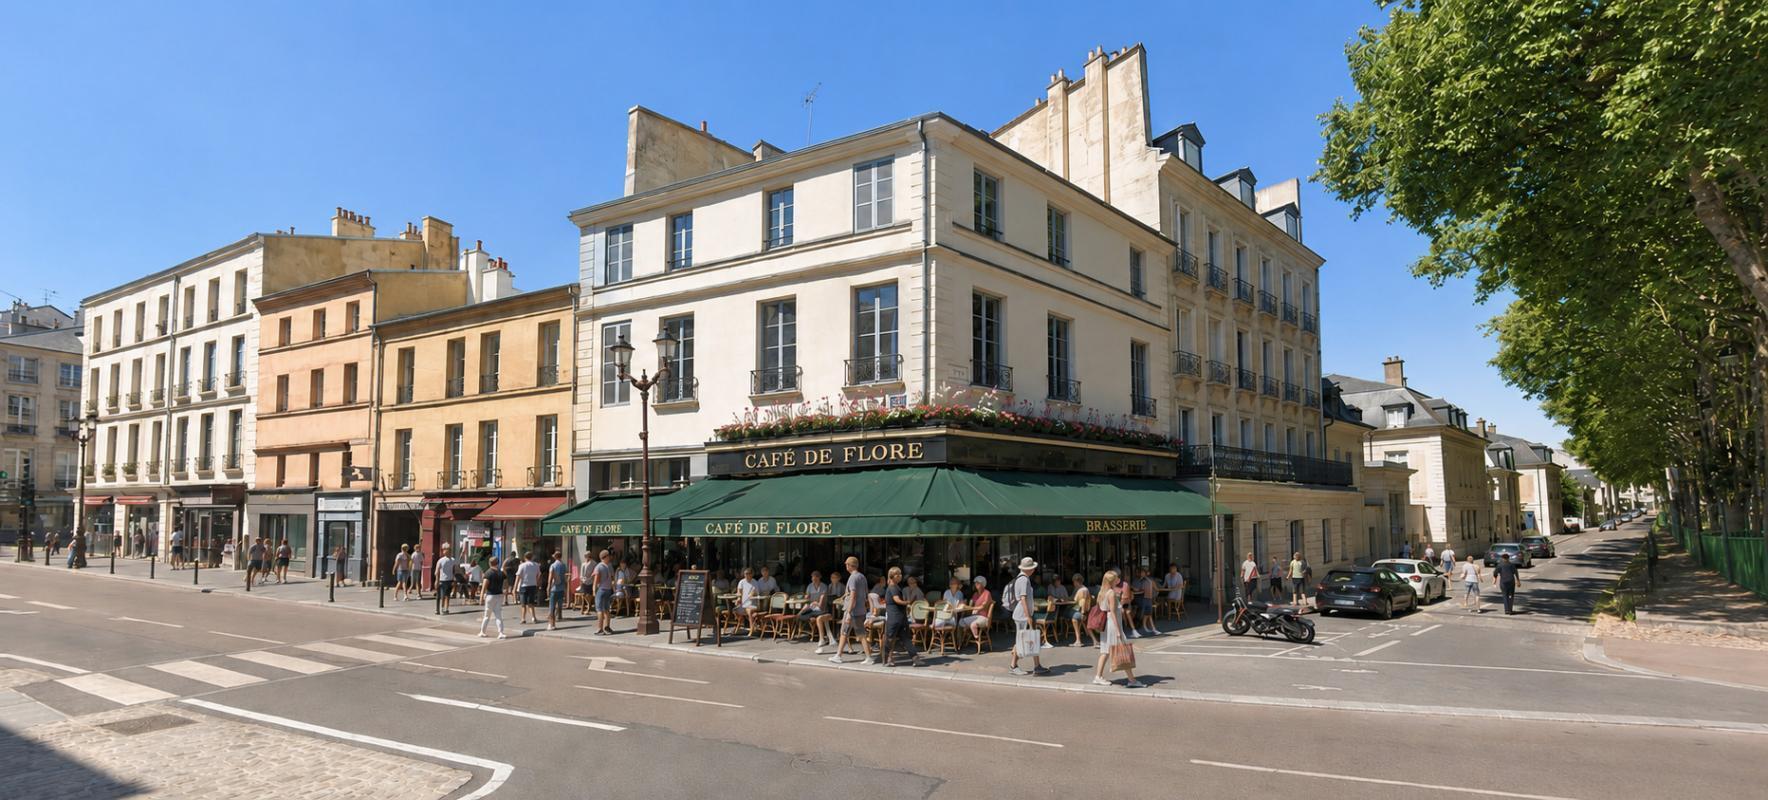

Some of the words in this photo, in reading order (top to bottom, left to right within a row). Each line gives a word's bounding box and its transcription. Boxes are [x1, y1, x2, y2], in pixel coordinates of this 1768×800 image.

[744, 448, 796, 469] CAFÉ
[804, 448, 833, 466] DE
[843, 442, 924, 463] FLORE
[595, 524, 622, 534] FLORE
[705, 520, 743, 534] CAFÉ
[748, 522, 769, 534] DE
[775, 521, 832, 534] FLORE
[1087, 520, 1146, 531] BRASSERIE
